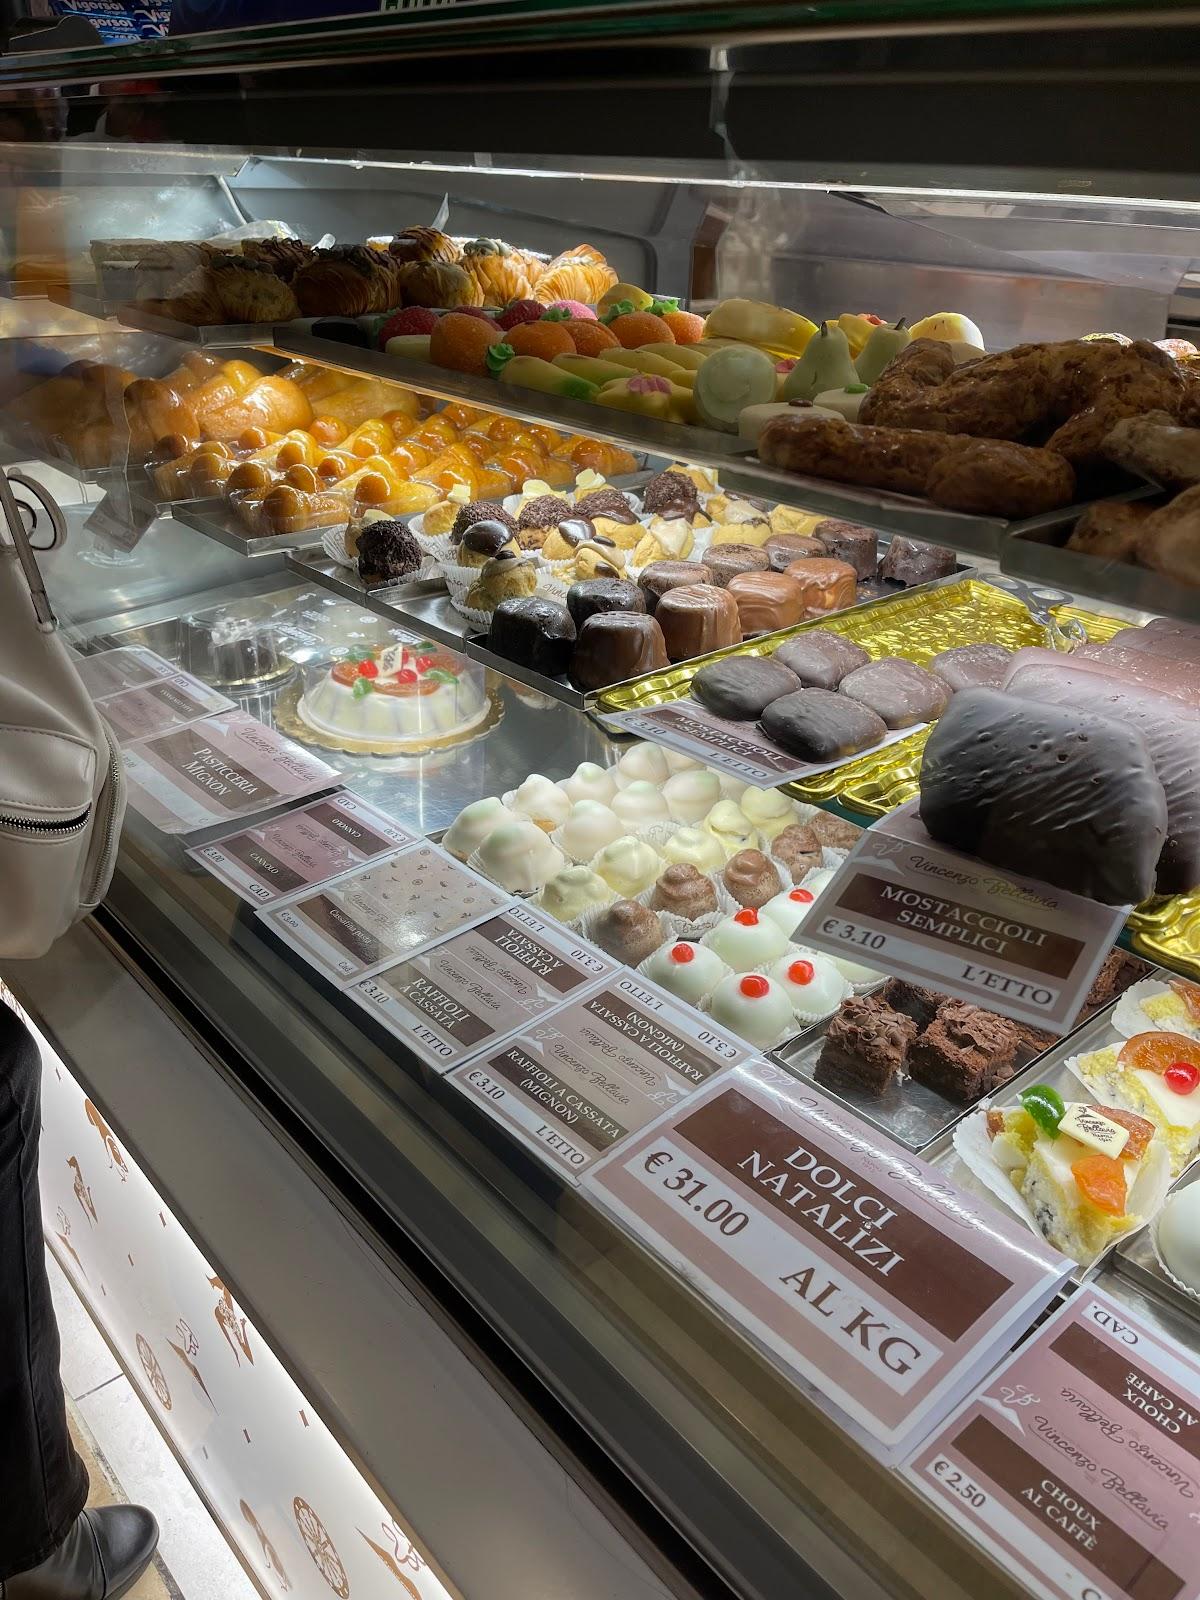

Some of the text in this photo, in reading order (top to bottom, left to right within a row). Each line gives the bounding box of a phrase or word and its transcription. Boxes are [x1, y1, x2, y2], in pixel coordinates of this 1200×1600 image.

[89, 18, 133, 29] gorsol
[543, 583, 567, 599] Vinc
[675, 716, 783, 762] MOSTACCIOLI
[181, 758, 233, 798] MIGNON
[193, 746, 260, 797] PASTICCERIA
[709, 752, 769, 779] L'ETTO
[910, 854, 1061, 912] Vincenzo Bellavia
[508, 907, 545, 934] L'ETTO
[838, 925, 886, 951] 3.10
[880, 884, 1048, 948] MOSTACCIOLI
[896, 909, 1008, 956] SEMPLICI
[494, 934, 553, 977] RAFFIOLI
[507, 928, 554, 964] CASSATA
[412, 977, 470, 1023] RAFFIOLI
[619, 980, 663, 1012] L'ETTO
[961, 964, 1054, 1007] L'ETTO
[407, 989, 454, 1030] CASSATA
[590, 1000, 640, 1038] CASSATA
[626, 1011, 686, 1052] (MIGNON)
[411, 1023, 454, 1058] L'ETTO
[652, 1043, 704, 1082] RAFFIOLI
[475, 1075, 506, 1101] 3.10
[506, 1050, 557, 1091] RAFFIOLI
[563, 1092, 621, 1139] CASSATA
[552, 1043, 630, 1106] Vincenzo Bellavia
[519, 1077, 580, 1125] (MIGNON)
[800, 1094, 884, 1153] Vincenzo
[535, 1124, 586, 1167] L'ETTO
[662, 1165, 750, 1237] 31.00
[783, 1144, 899, 1232] DOLCI
[736, 1149, 906, 1278] NATALIZI
[778, 1265, 924, 1378] AL KG
[1091, 1303, 1140, 1347] CAD.
[1122, 1387, 1182, 1435] CHOUX
[1125, 1370, 1199, 1428] AL CAFFÈ
[943, 1468, 987, 1509] 2.50
[1033, 1414, 1170, 1531] Vincenzo Bellavia
[1021, 1486, 1099, 1552] AL CAFFÈ
[1040, 1478, 1103, 1531] CHOUX
